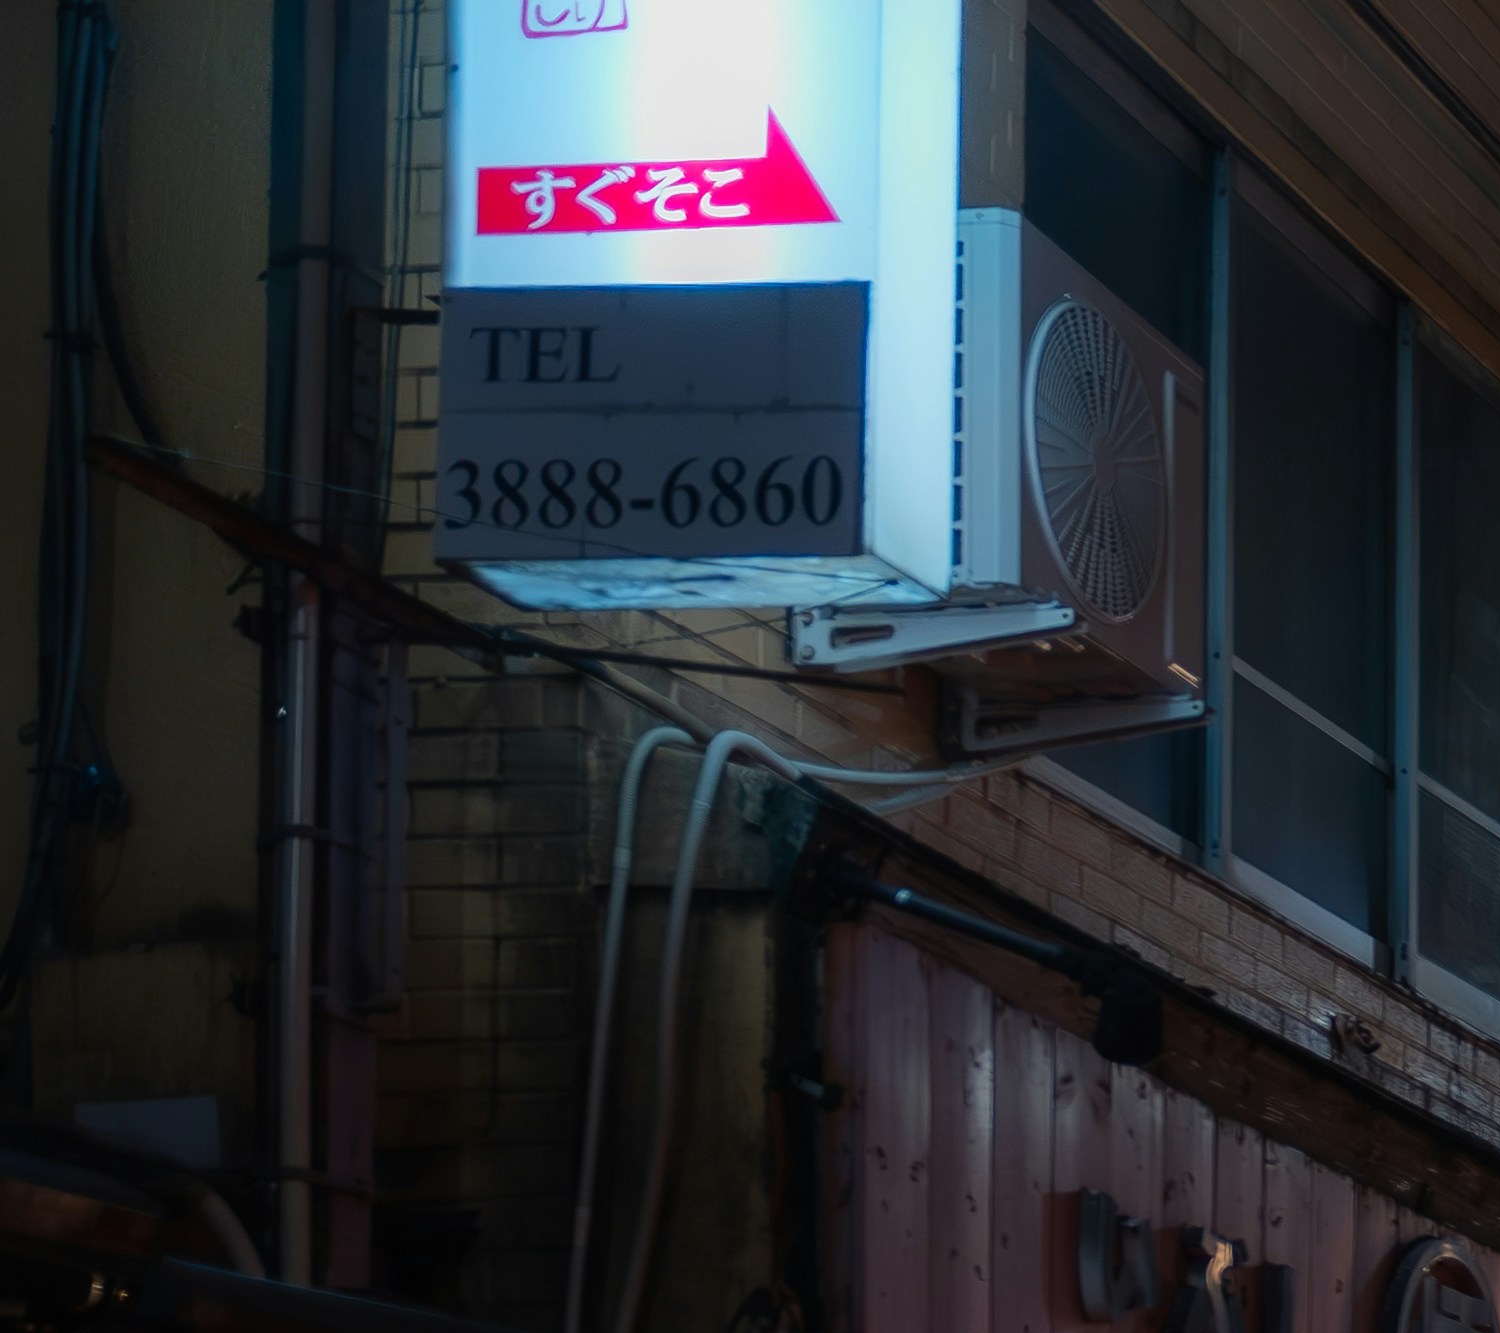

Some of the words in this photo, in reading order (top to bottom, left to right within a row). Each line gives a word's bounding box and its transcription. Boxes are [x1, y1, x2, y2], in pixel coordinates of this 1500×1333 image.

[510, 165, 751, 230] すぐそこ
[468, 326, 622, 384] TEL
[444, 454, 844, 532] 3888-6860
